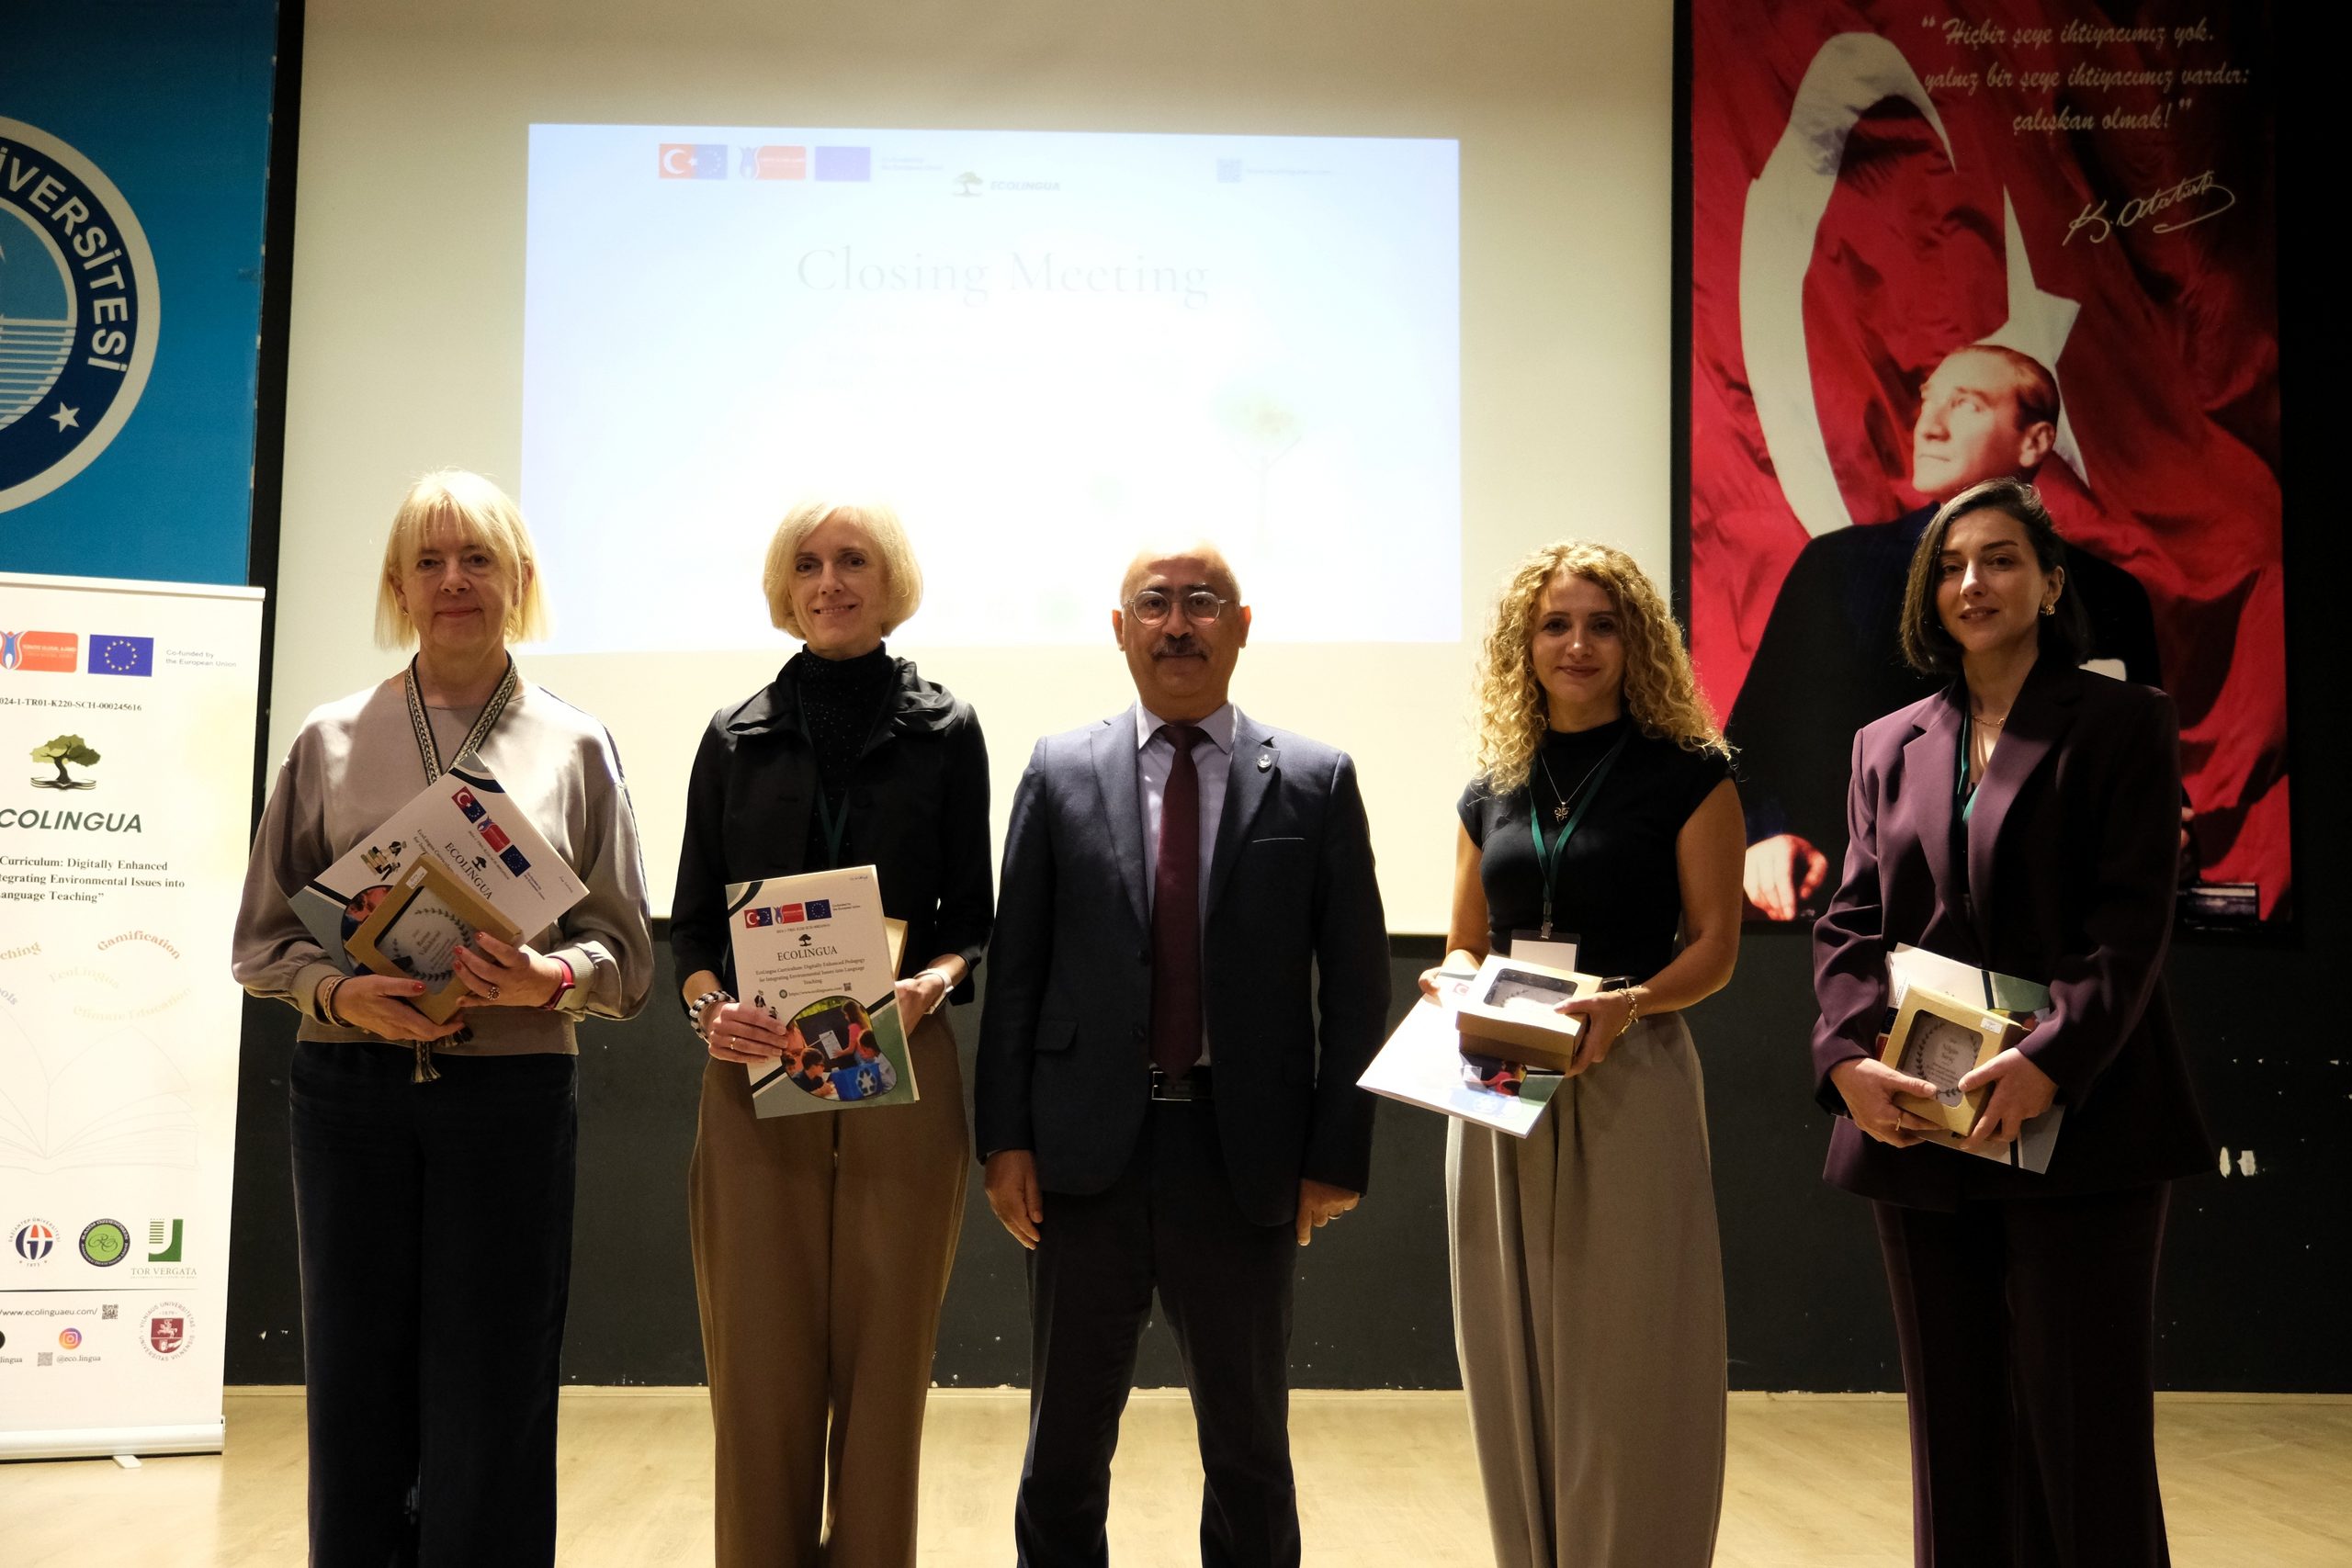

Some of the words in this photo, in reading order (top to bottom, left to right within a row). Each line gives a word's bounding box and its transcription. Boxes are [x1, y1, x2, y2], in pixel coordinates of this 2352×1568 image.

[2012, 27, 2052, 51] şeye
[2060, 17, 2165, 51] ihtiyacımız
[2173, 17, 2215, 49] yok.
[1924, 65, 1980, 96] yalnız
[1986, 62, 2014, 88] bir
[2020, 73, 2061, 94] şeye
[2067, 62, 2174, 94] ihtiyacımız
[2012, 106, 2095, 137] çalışkan
[989, 180, 1062, 192] ECOLINGUA
[797, 243, 990, 309] Closing
[1009, 250, 1211, 310] Meeting
[165, 649, 204, 658] Co-funded
[178, 659, 214, 667] European
[0, 855, 63, 867] Curriculum:
[67, 858, 114, 872] Digitally
[118, 860, 168, 871] Enhanced
[445, 841, 493, 900] ECOLINGUA
[50, 874, 128, 886] Environmental
[130, 876, 162, 887] Issues
[164, 877, 186, 888] into
[0, 890, 46, 902] anguage
[97, 930, 181, 960] Gamification
[777, 945, 838, 962] ECOLINGUA
[130, 1267, 150, 1276] TOR
[153, 1267, 198, 1276] VERGATA
